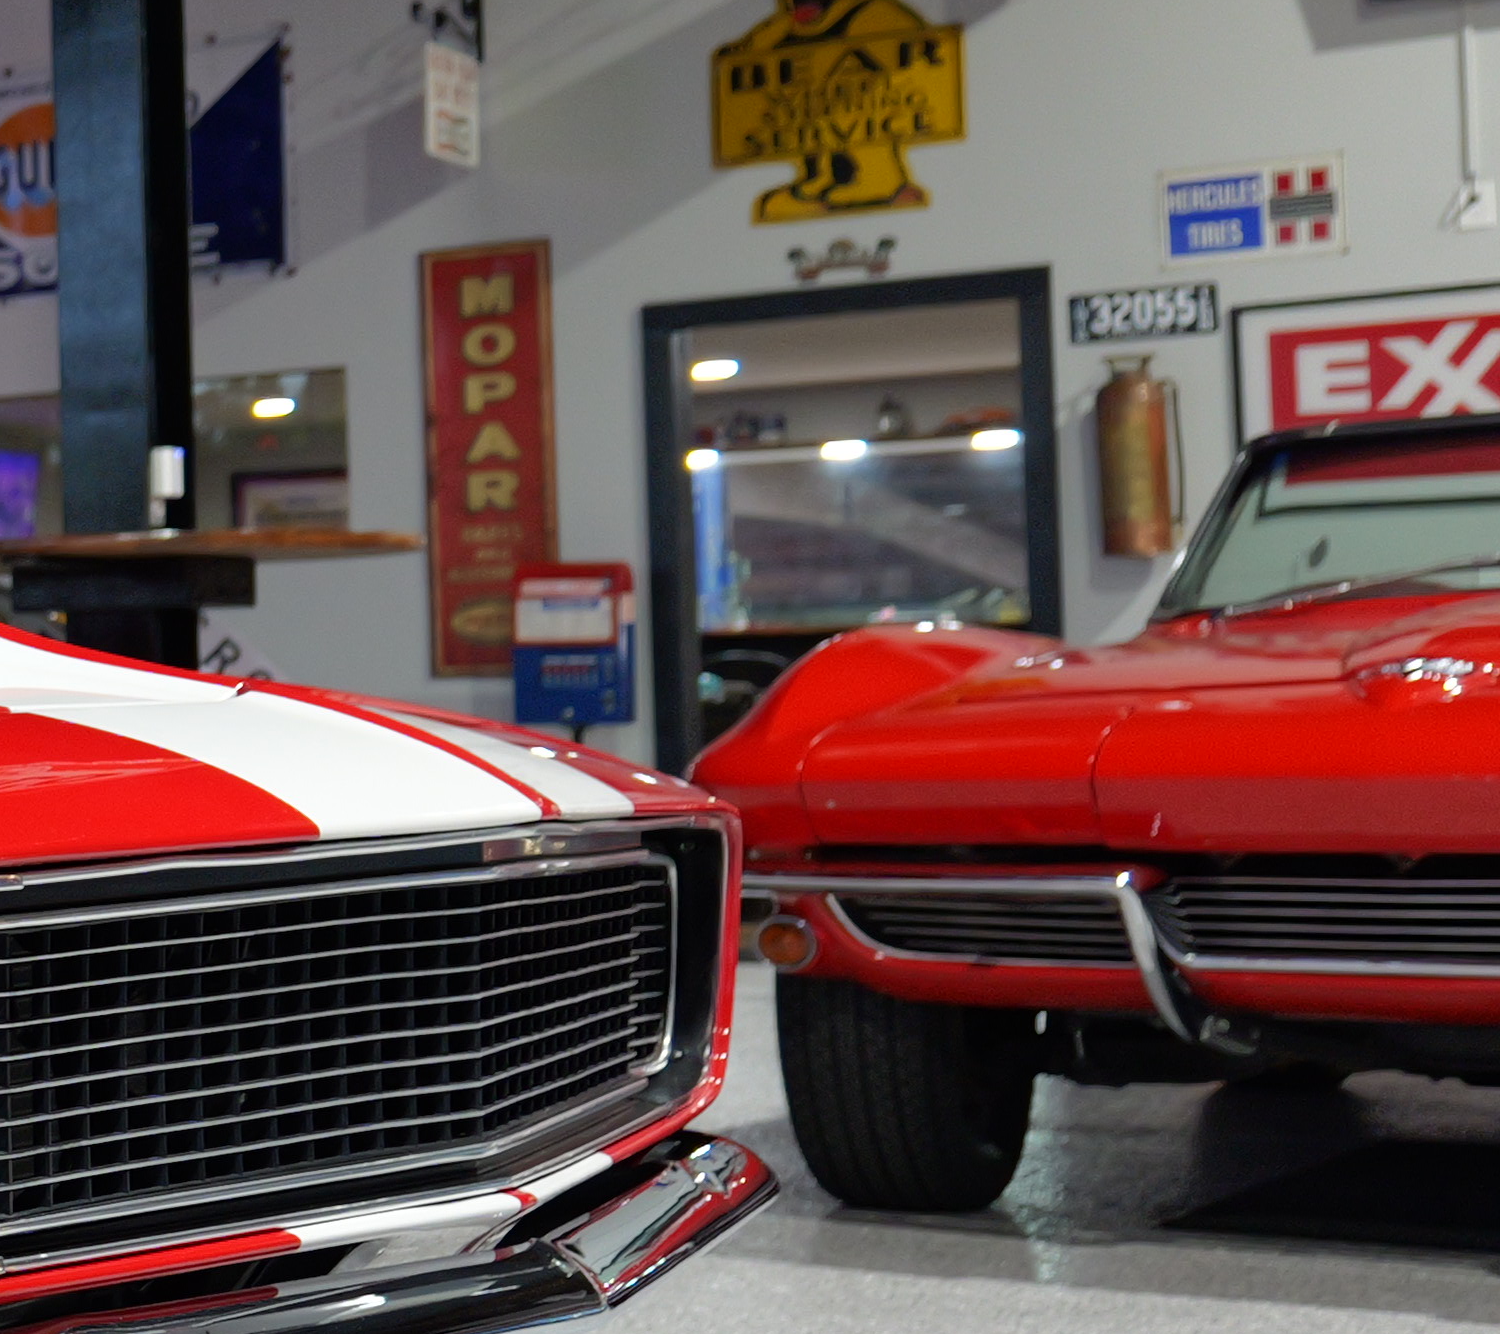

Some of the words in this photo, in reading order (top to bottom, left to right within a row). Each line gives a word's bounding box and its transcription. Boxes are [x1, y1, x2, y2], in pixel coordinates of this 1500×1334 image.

[731, 39, 944, 93] BEAR
[743, 111, 932, 155] SERVICE
[1166, 178, 1264, 214] HERCULES
[1186, 217, 1245, 251] TIRES
[1088, 287, 1197, 335] 32055
[458, 271, 522, 514] MOPAR
